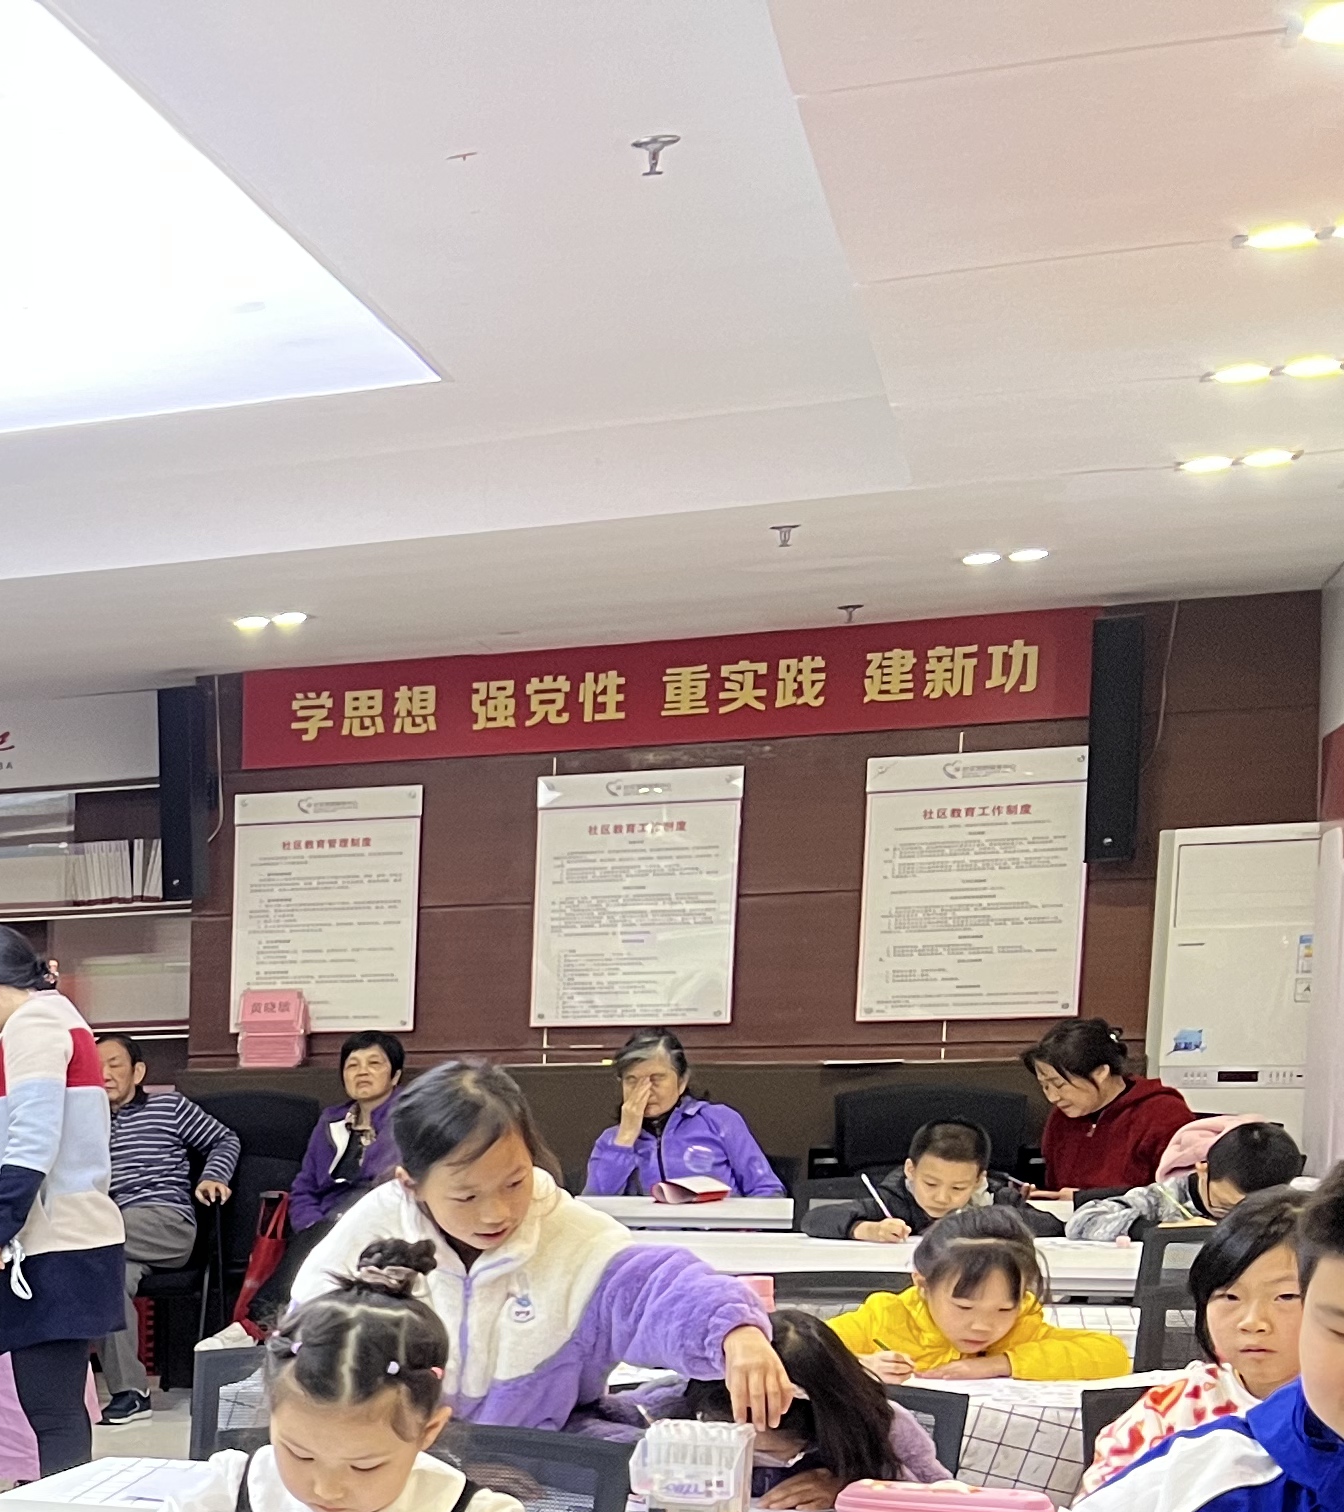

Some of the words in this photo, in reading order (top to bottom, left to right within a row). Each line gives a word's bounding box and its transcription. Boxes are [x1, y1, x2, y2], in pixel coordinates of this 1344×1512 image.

[290, 685, 438, 742] 学思想
[471, 669, 627, 731] 强党性
[660, 654, 827, 717] 重实践
[862, 638, 1040, 704] 建新功
[922, 803, 1033, 821] 社区教育工作制度
